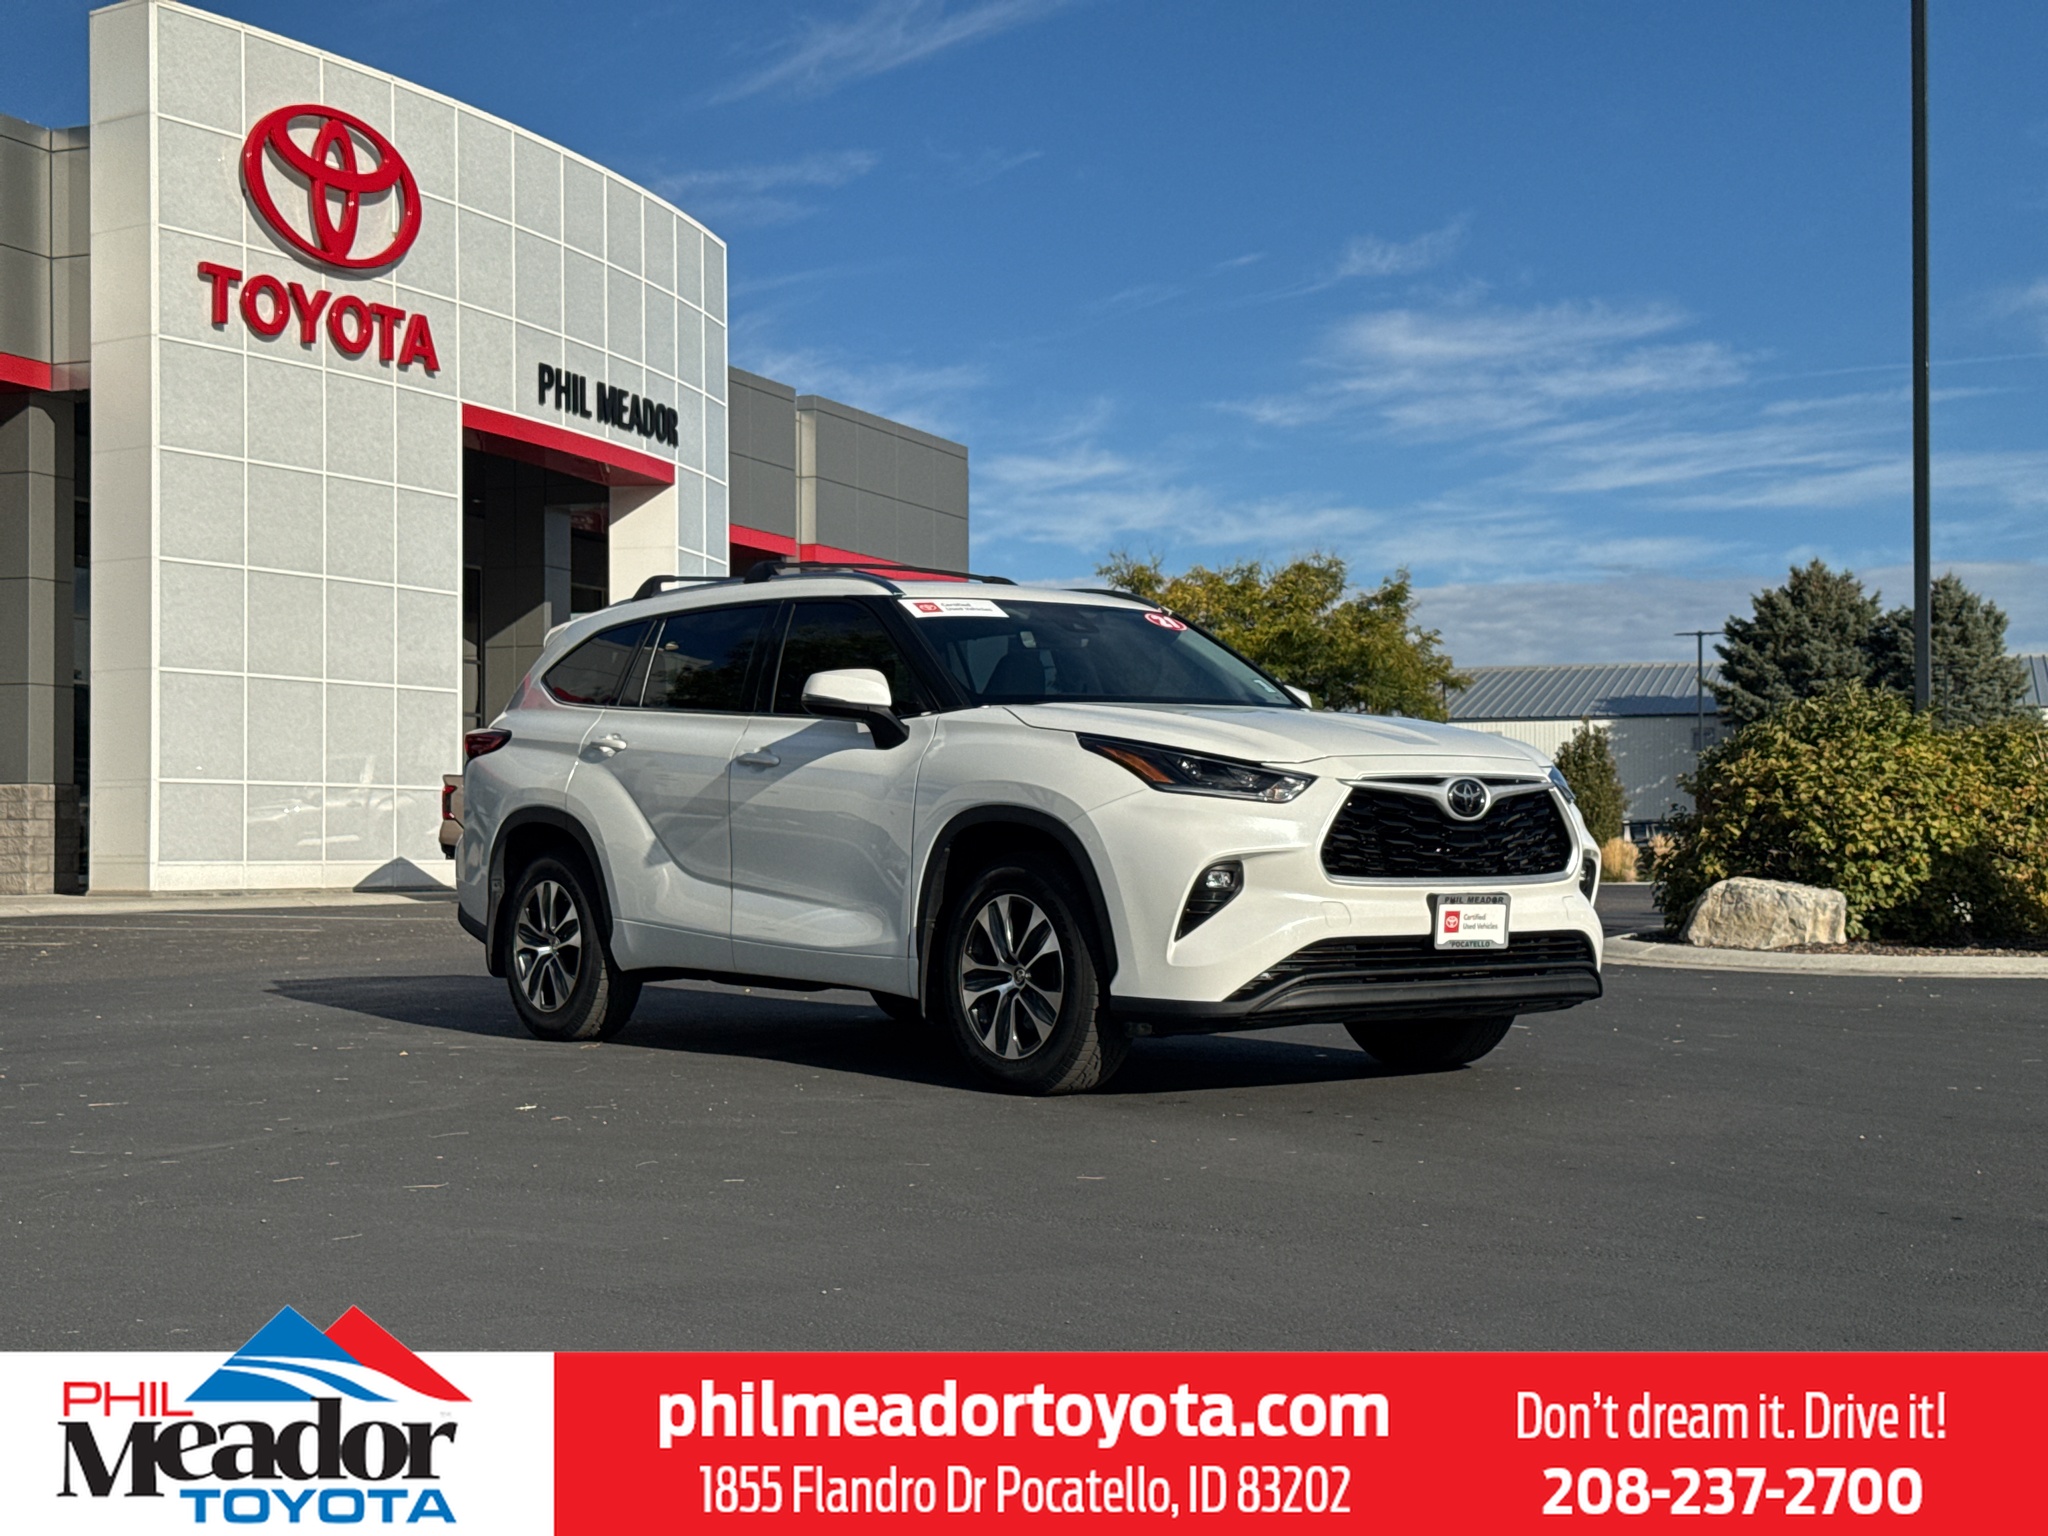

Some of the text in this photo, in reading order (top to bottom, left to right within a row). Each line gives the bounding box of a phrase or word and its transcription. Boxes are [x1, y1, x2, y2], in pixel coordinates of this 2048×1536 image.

[198, 261, 440, 372] TOYOTA
[538, 362, 679, 449] PHIL MEADOR
[1444, 896, 1505, 904] PHIL MEADOR
[1463, 913, 1487, 921] Certified
[1462, 922, 1499, 930] Used Vehicles
[1451, 940, 1491, 948] POCATELLO
